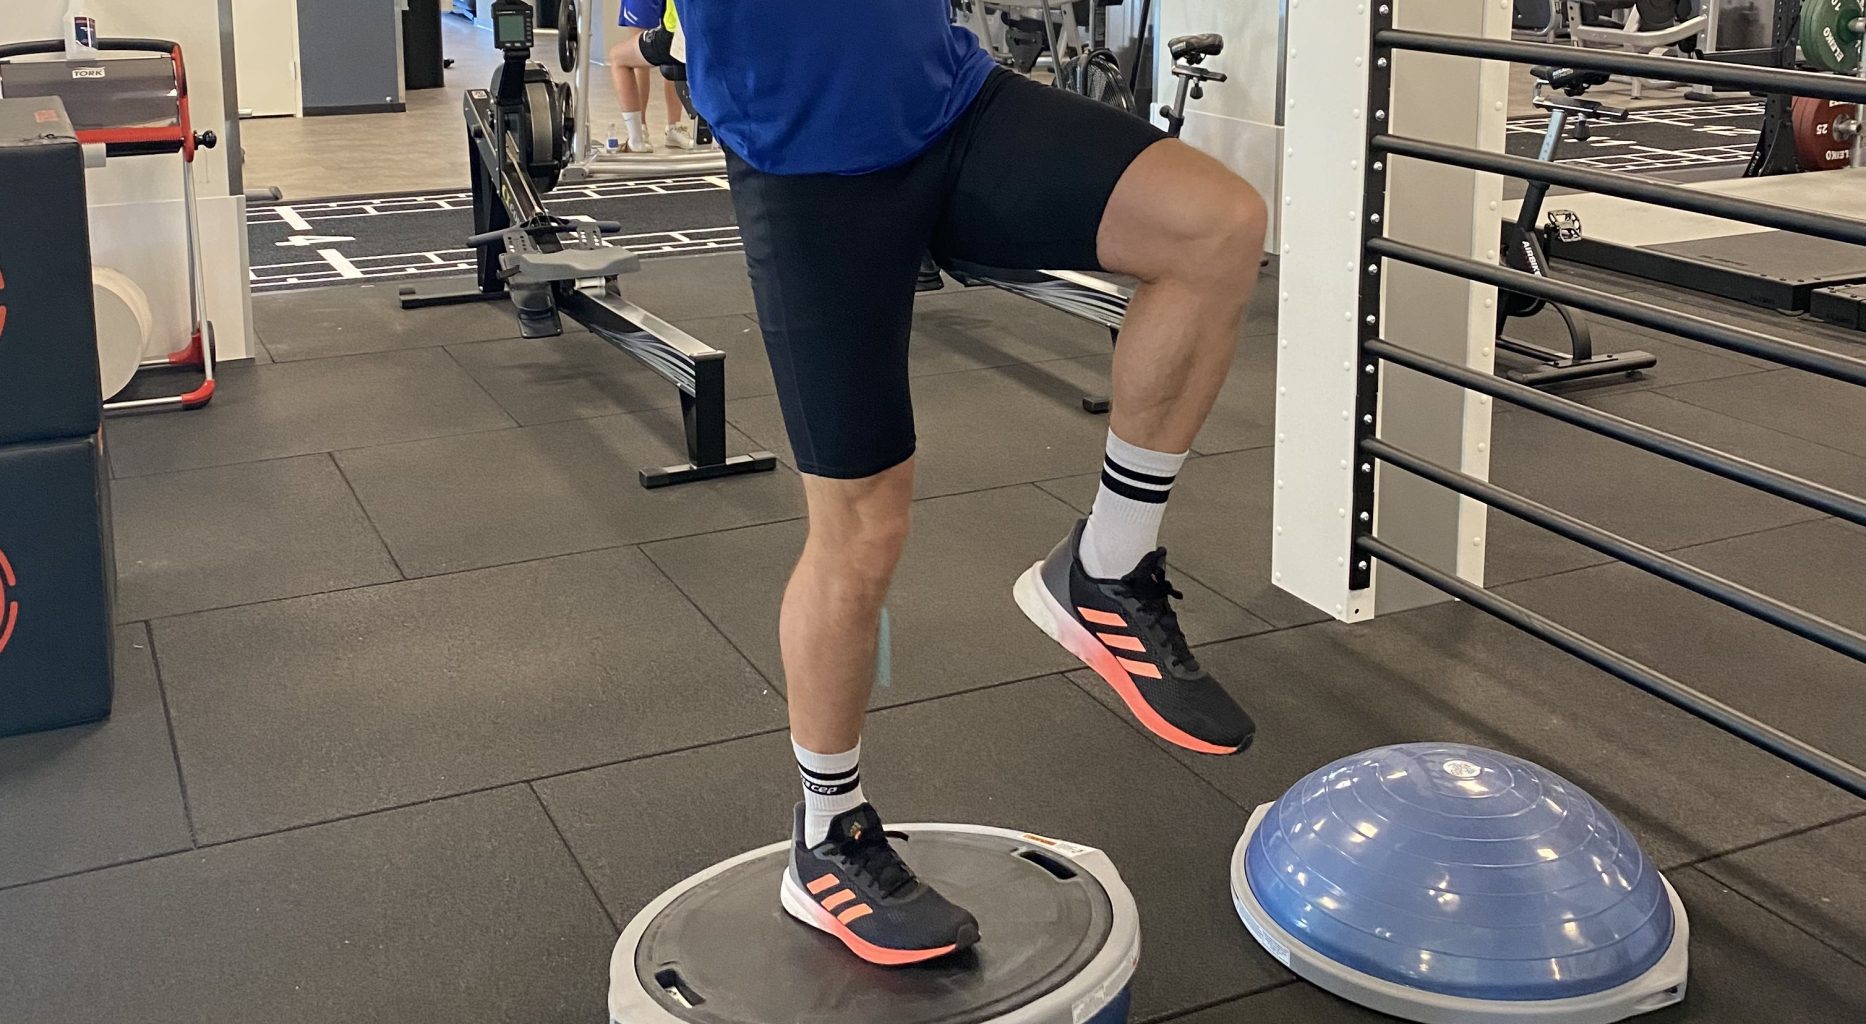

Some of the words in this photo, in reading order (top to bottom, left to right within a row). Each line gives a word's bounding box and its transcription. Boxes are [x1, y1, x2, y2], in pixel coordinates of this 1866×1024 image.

[1823, 26, 1845, 63] ELEIKO
[1816, 123, 1829, 135] 25
[1825, 149, 1850, 161] LEIKO
